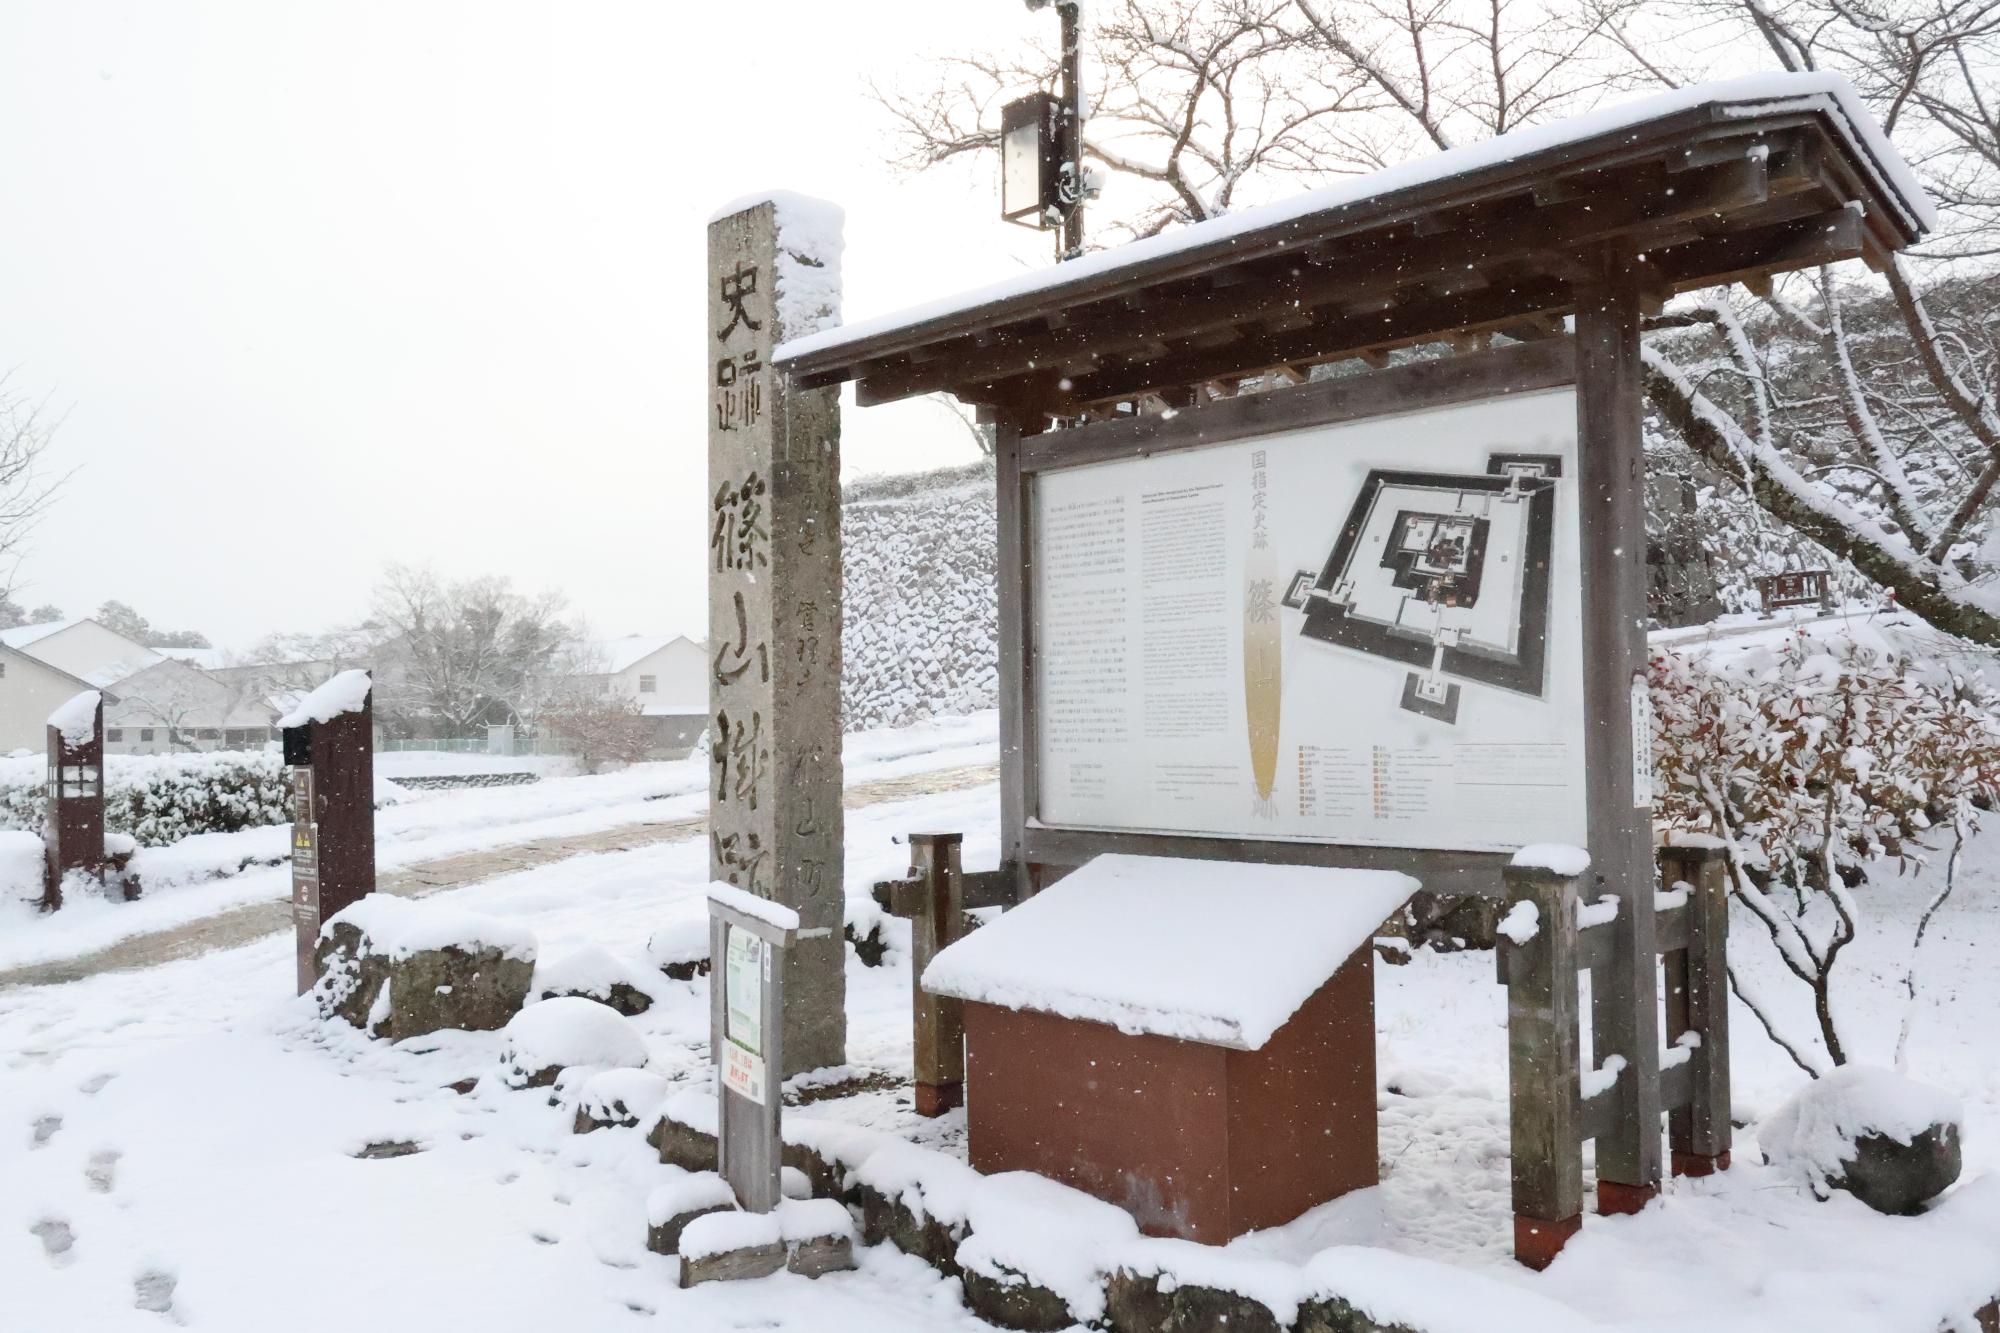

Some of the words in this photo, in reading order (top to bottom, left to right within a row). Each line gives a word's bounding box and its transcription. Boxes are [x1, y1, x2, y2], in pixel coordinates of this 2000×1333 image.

[1251, 450, 1268, 550] 国指定史跡
